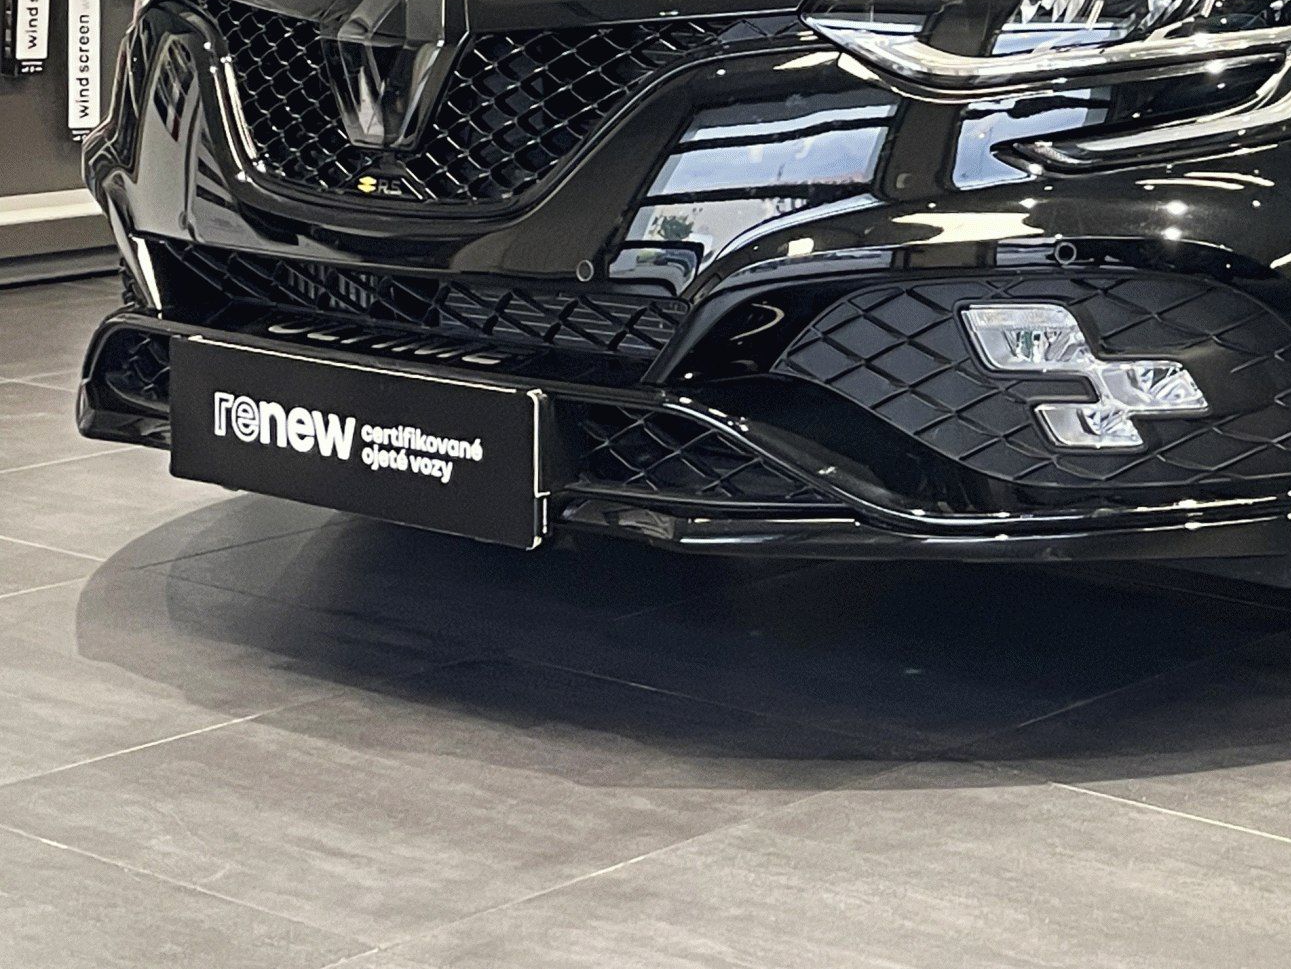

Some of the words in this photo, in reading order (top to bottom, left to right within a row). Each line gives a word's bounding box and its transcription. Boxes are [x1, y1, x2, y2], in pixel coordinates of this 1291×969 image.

[26, 6, 39, 50] wind
[78, 13, 90, 73] screen
[76, 77, 90, 119] wind
[213, 390, 356, 460] renew
[361, 423, 484, 462] certifikované
[361, 444, 409, 471] ojeté
[410, 456, 453, 484] vozy
